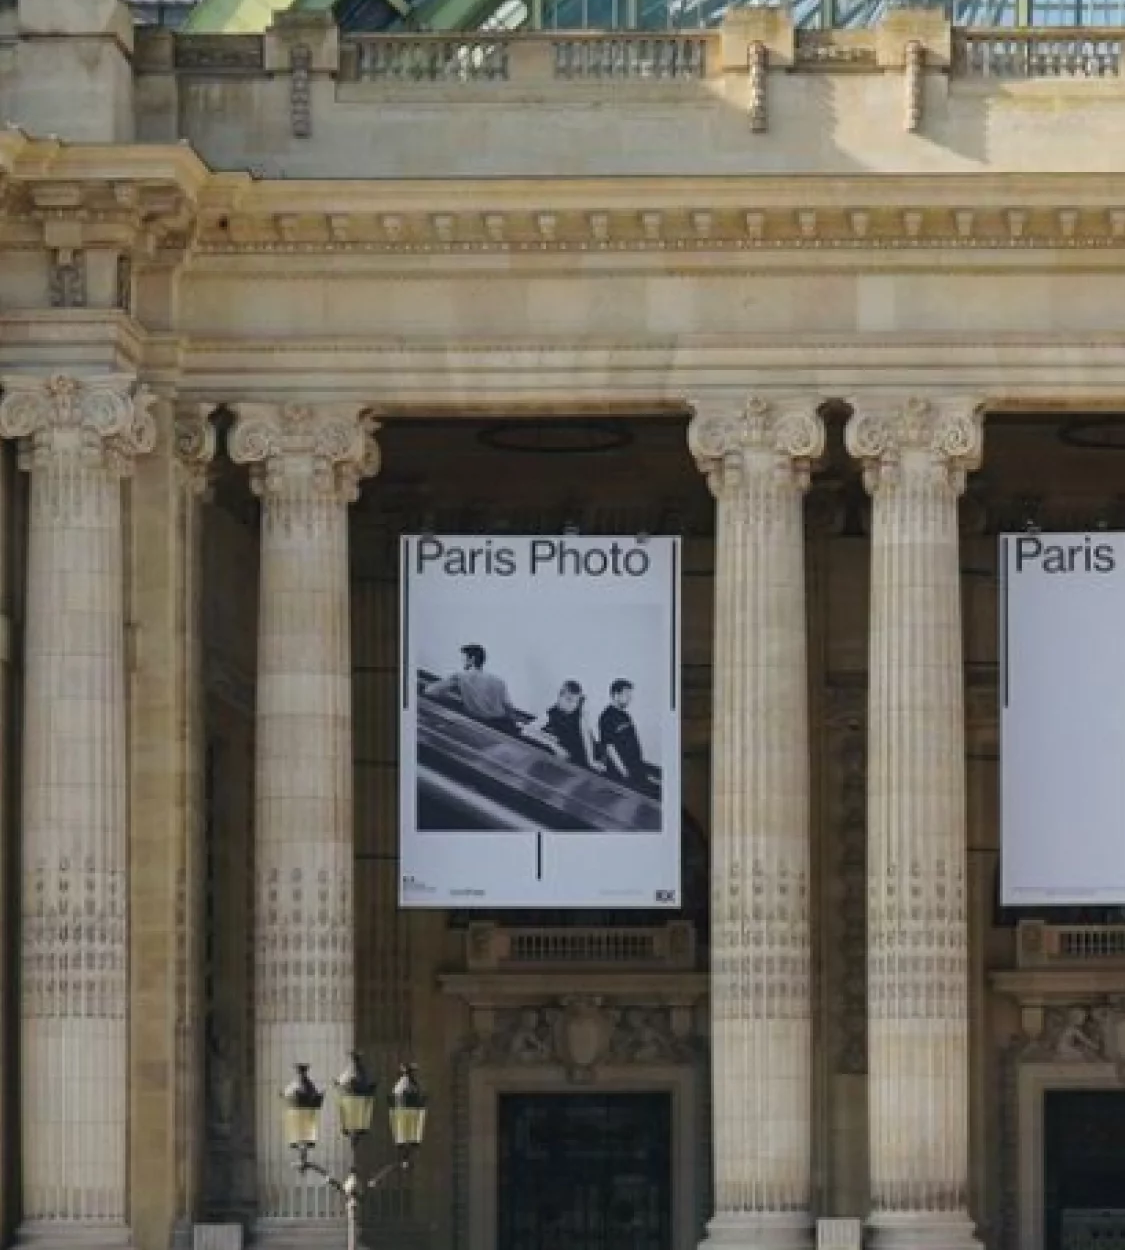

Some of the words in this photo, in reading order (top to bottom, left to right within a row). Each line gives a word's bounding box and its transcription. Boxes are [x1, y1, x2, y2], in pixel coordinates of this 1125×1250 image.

[415, 539, 516, 575] Paris
[530, 539, 649, 576] Photo
[1015, 535, 1115, 573] Paris
